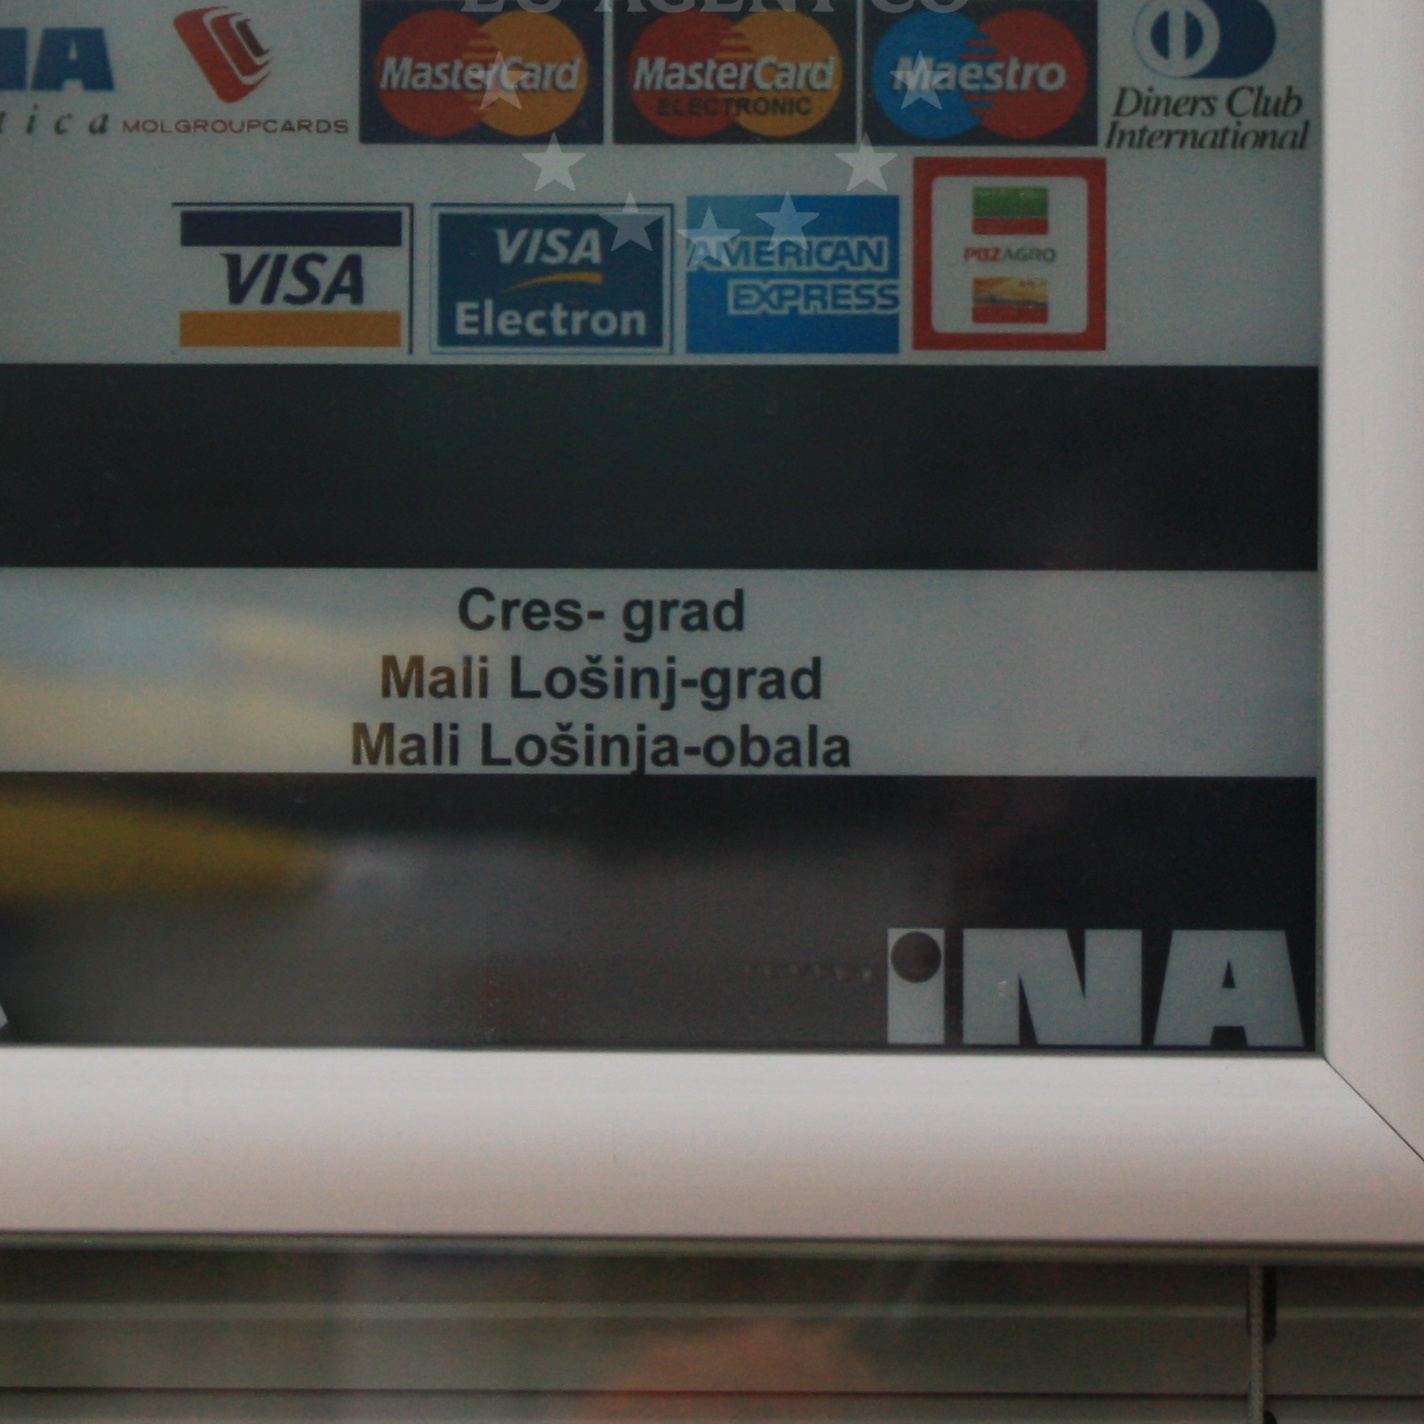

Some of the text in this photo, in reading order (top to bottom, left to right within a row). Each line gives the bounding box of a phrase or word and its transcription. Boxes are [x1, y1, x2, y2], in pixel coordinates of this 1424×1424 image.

[380, 54, 580, 93] MasterCard
[632, 54, 836, 93] MasterCard
[891, 54, 1066, 93] Maestro
[657, 96, 812, 118] ELECTRONIC
[1112, 84, 1303, 119] Diners Club
[121, 118, 349, 135] MOLGROUPCARDS
[1105, 120, 1310, 152] International
[493, 226, 604, 266] VISA
[686, 234, 889, 272] AMERICAN
[222, 251, 366, 307] VISA
[729, 278, 901, 316] EXPRESS
[456, 299, 648, 339] Electron
[457, 586, 745, 643] Cres- grad
[380, 653, 822, 711] Mali Lošinj-grad
[351, 721, 852, 776] Mali Lošinja-obala
